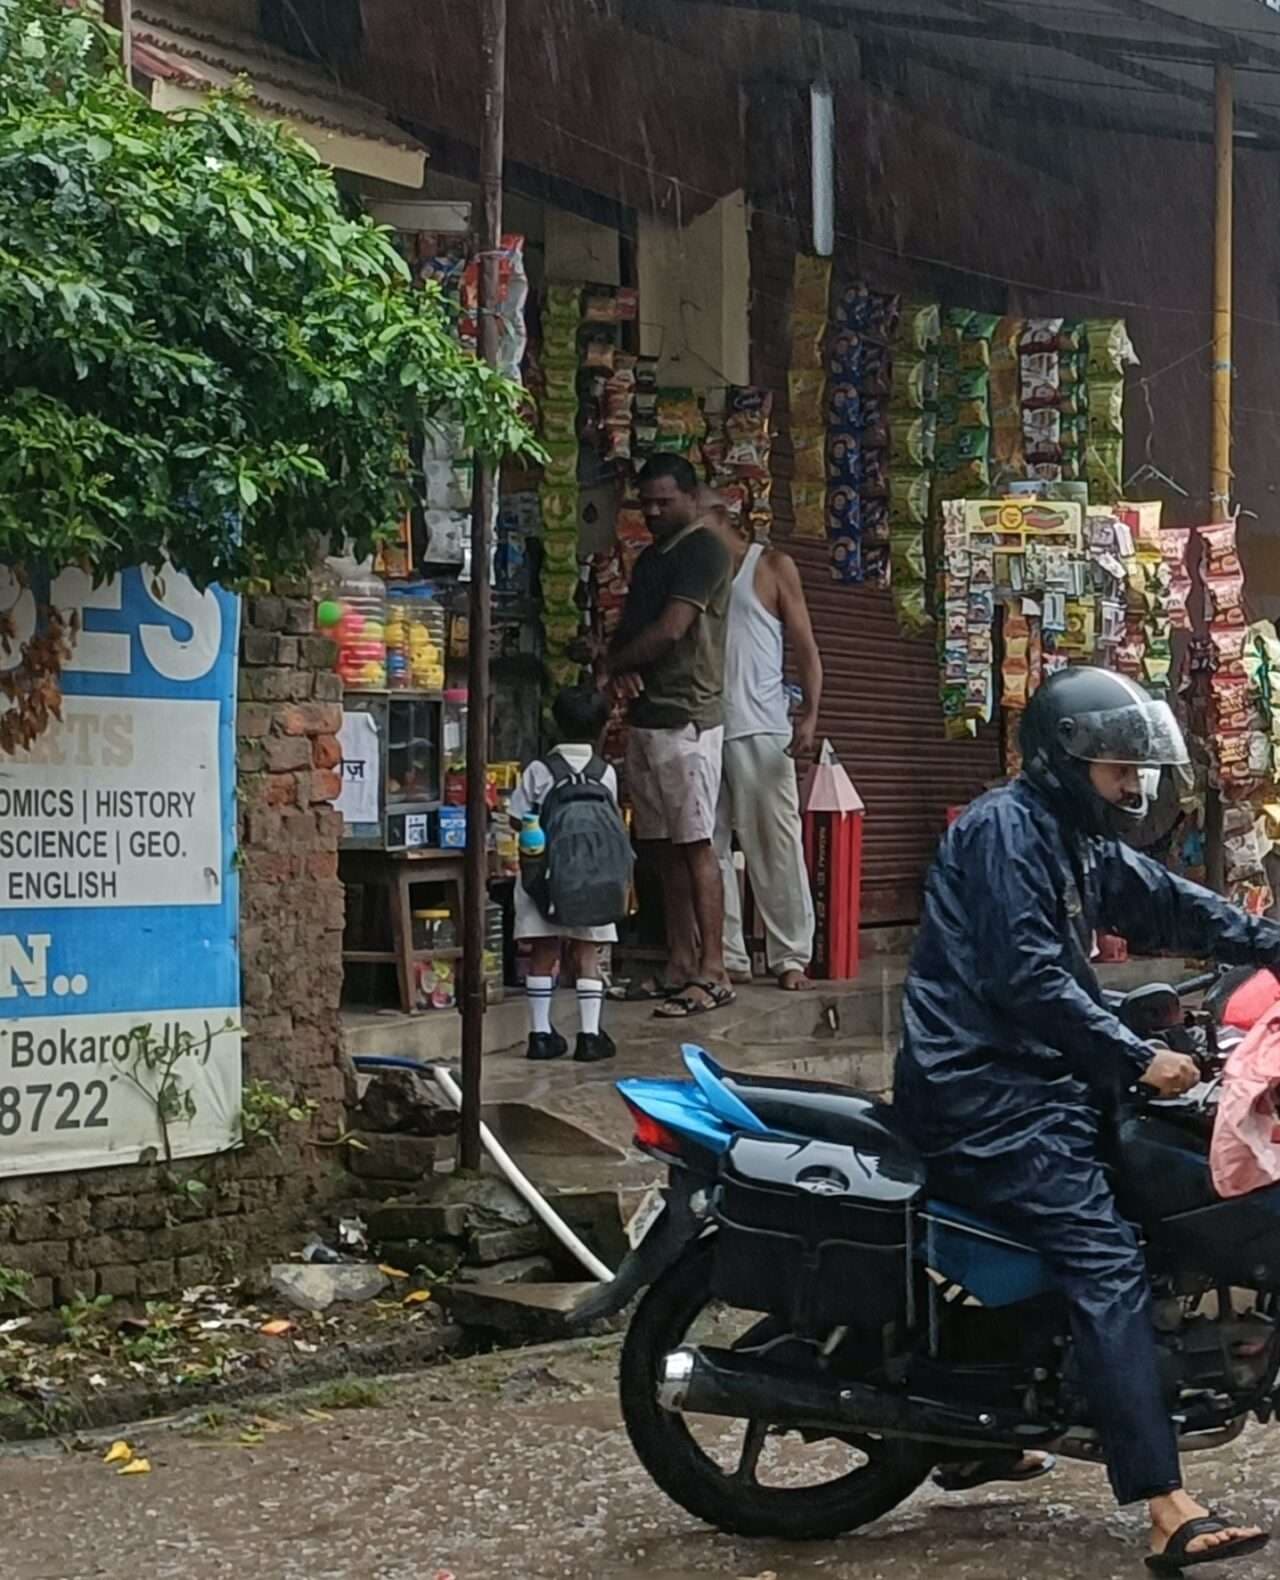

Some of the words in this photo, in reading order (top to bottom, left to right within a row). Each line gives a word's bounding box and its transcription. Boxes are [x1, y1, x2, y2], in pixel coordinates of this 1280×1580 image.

[95, 790, 196, 818] HISTORY
[0, 830, 108, 858] SCIENCE
[129, 830, 187, 858] GEO.
[8, 871, 117, 899] ENGLISH
[11, 1028, 130, 1068] Bokaro
[0, 1080, 109, 1136] 8722
